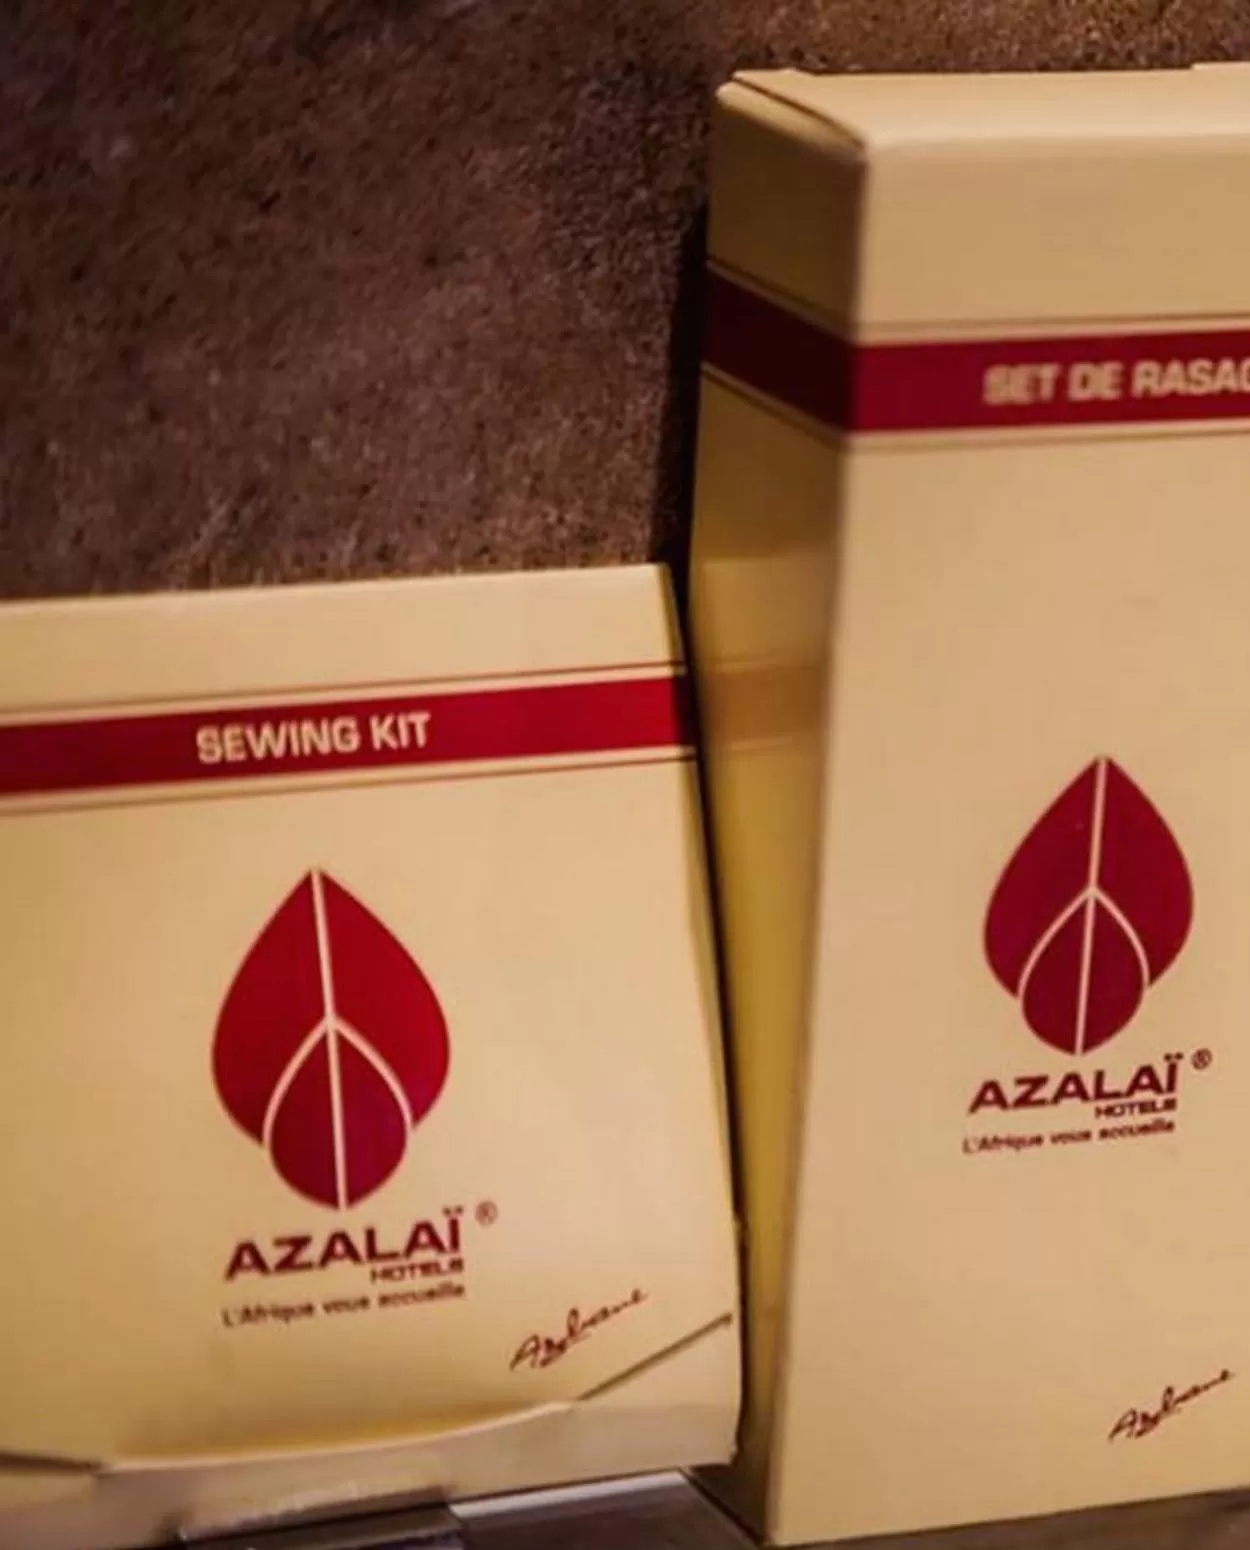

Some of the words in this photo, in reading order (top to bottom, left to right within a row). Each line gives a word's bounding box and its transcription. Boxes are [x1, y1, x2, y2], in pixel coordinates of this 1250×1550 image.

[983, 364, 1060, 406] SET
[1067, 361, 1124, 401] DE
[195, 714, 362, 764] SEWING
[368, 709, 431, 750] KIT
[967, 1051, 1184, 1115] AZALAÏ
[1095, 1097, 1178, 1119] HOTELS
[223, 1205, 465, 1281] AZALAÏ
[369, 1257, 466, 1284] HOTELS
